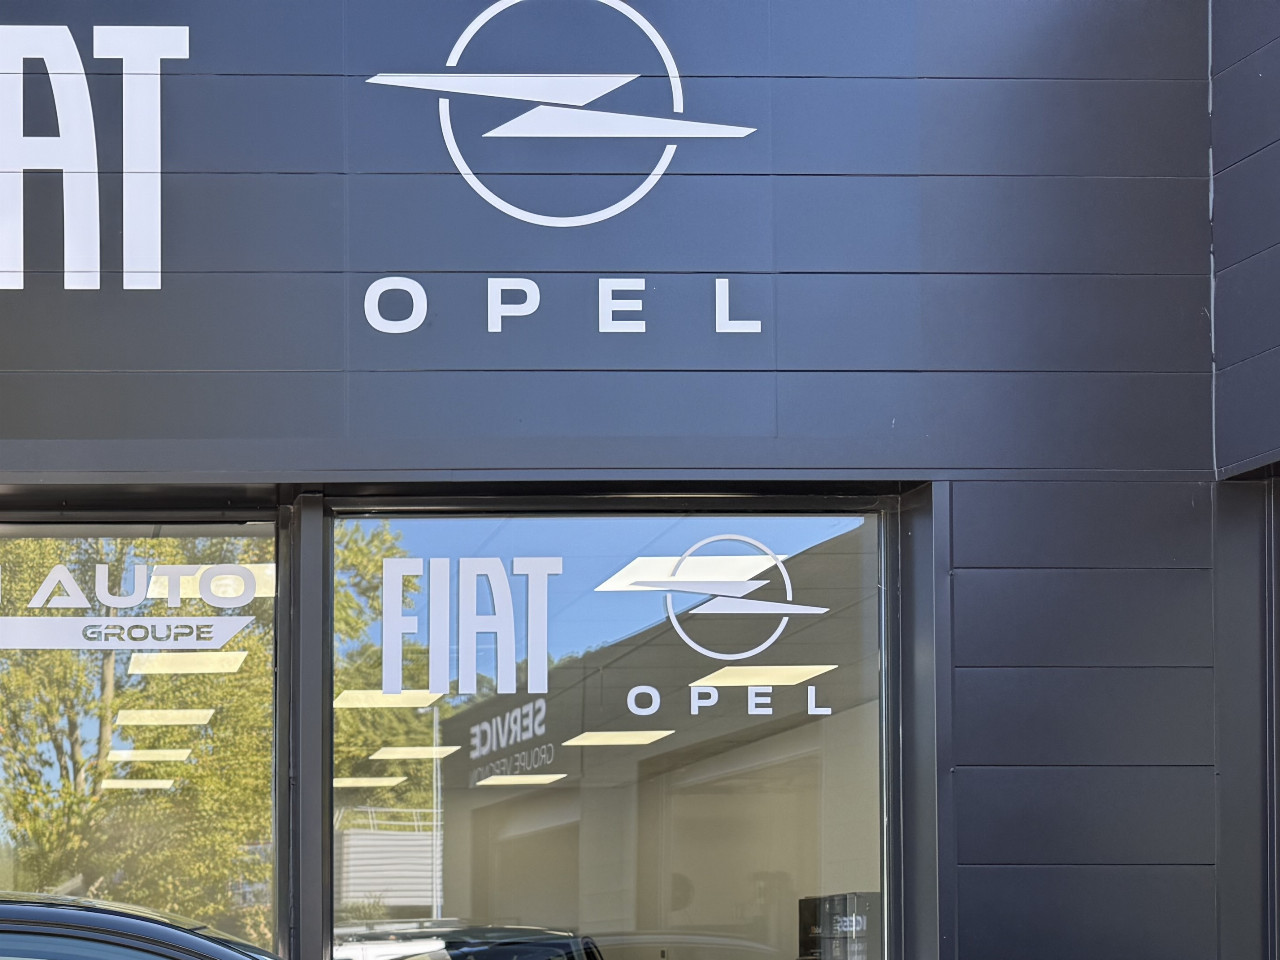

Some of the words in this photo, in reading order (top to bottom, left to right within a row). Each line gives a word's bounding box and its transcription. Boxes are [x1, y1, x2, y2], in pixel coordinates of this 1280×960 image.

[364, 276, 763, 334] OPEL
[26, 563, 257, 609] AUTO
[81, 623, 214, 643] GROUPE
[382, 556, 564, 695] FIAT
[625, 685, 833, 716] OPEL
